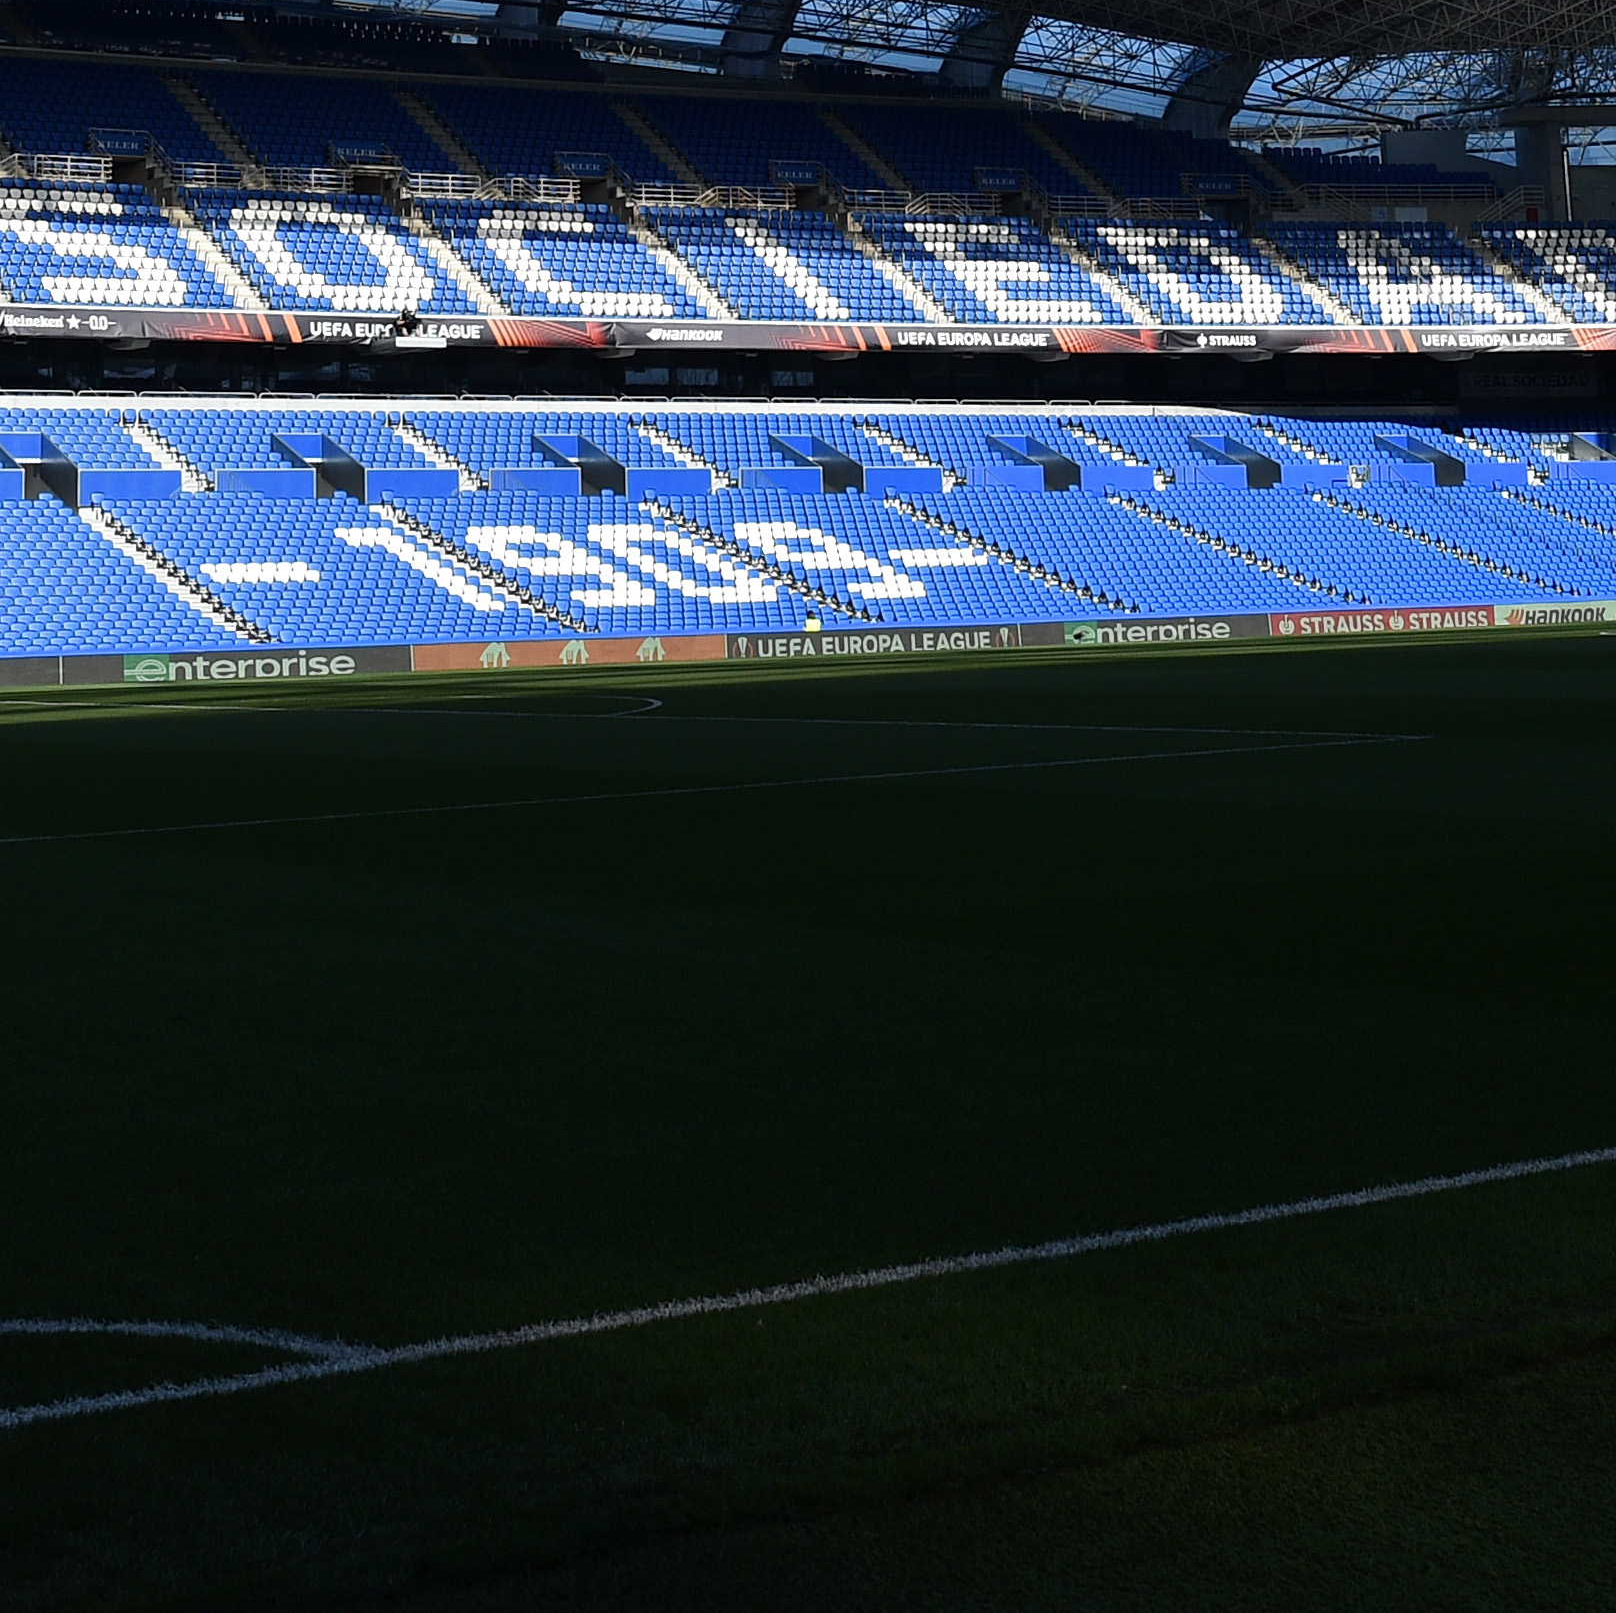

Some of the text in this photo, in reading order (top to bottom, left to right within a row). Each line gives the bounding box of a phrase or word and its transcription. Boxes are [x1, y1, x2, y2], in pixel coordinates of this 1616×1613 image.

[97, 140, 140, 150] KELER
[4, 314, 64, 329] Heineken
[310, 321, 353, 337] UEFA
[419, 324, 481, 339] LEAGUE
[897, 331, 1048, 346] UEFA EUROPA LEAGUE
[1209, 334, 1257, 347] STRAUSS
[1422, 332, 1566, 347] UEFA EUROPA LEAGUE
[1071, 617, 1231, 643] enterprise
[1300, 610, 1488, 634] STRAUSS STRAUSS
[757, 630, 992, 658] UEFA EUROPA LEAGUE
[128, 650, 356, 682] enterprise
